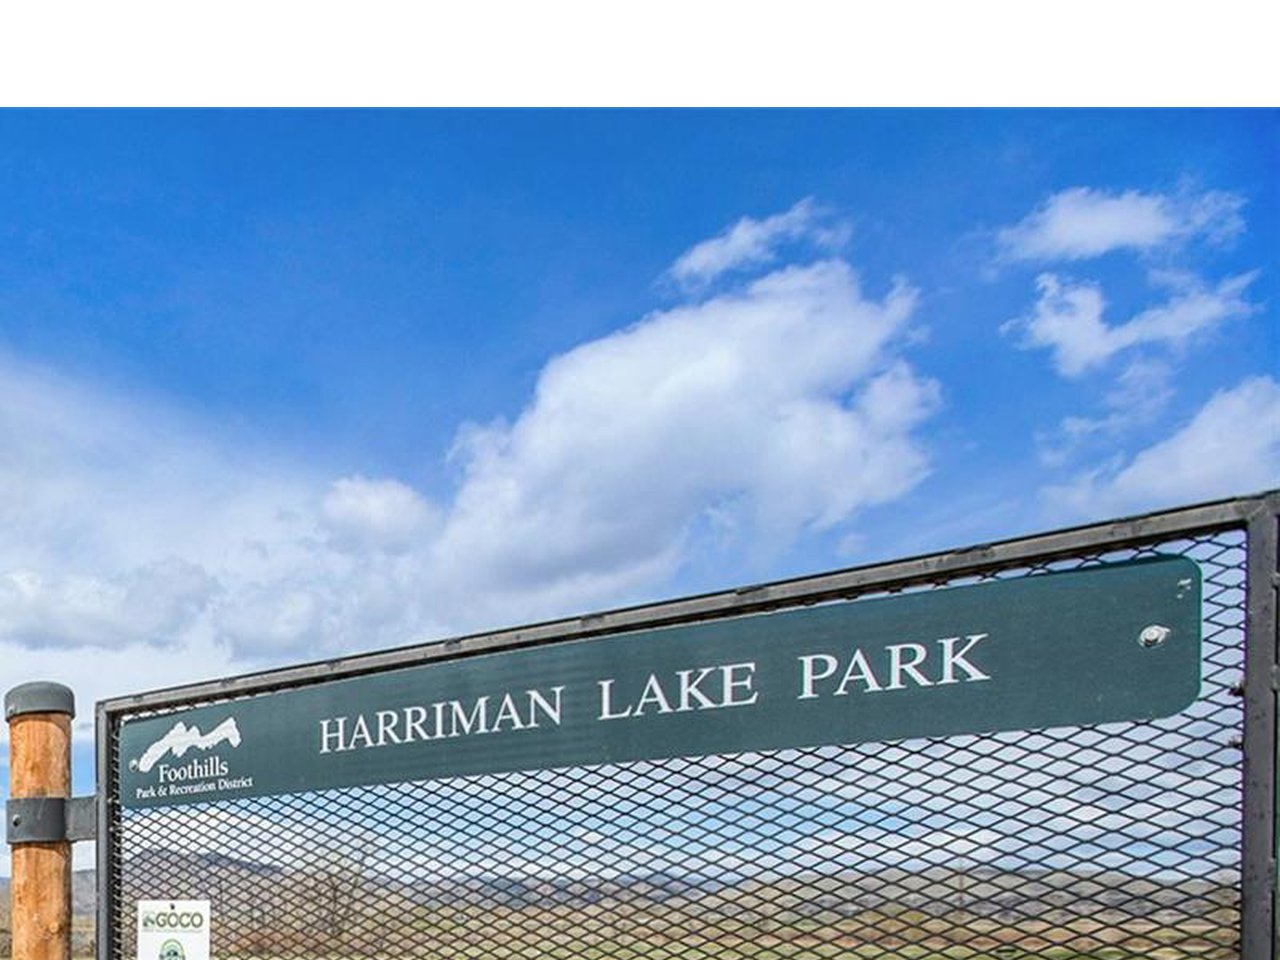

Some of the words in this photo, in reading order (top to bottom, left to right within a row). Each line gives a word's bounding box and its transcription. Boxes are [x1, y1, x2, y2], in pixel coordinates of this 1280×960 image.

[320, 685, 566, 755] HARRIMAN
[598, 661, 759, 721] LAKE
[798, 633, 991, 700] PARK
[159, 756, 229, 783] Foothills
[136, 786, 156, 798] Park
[169, 781, 216, 796] Recreation
[218, 776, 253, 790] District
[156, 912, 203, 928] GOCO
